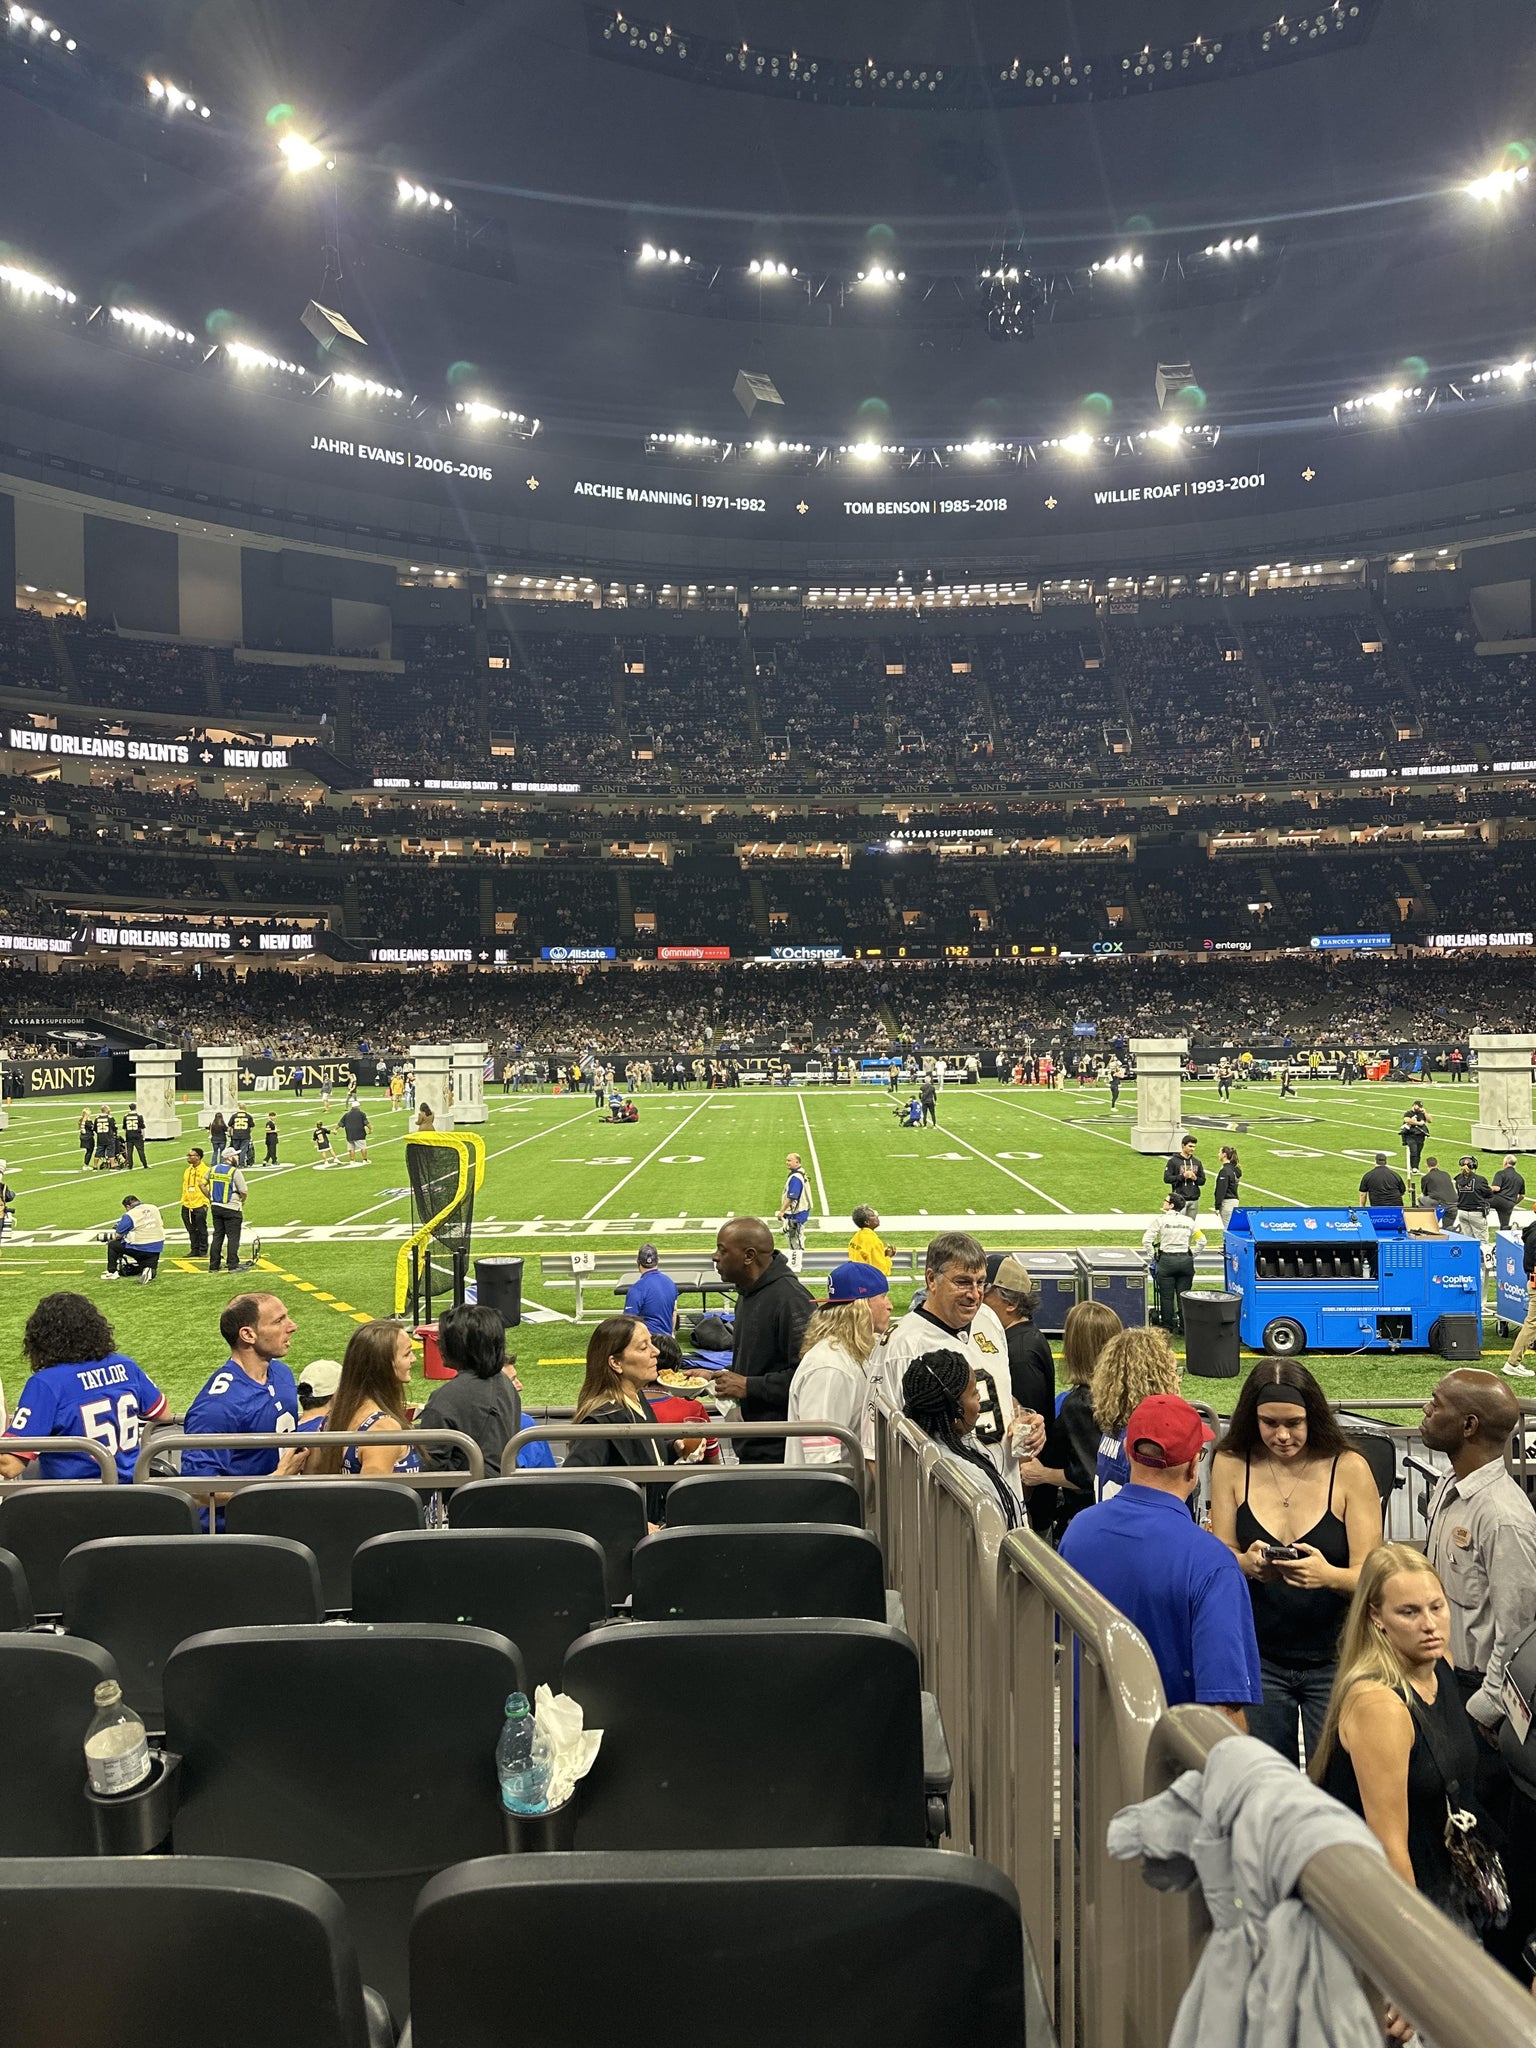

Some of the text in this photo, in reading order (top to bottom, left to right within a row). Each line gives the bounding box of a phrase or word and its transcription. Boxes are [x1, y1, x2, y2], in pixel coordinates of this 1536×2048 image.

[311, 436, 493, 481] JAHRI EVANS 2006-2016
[1094, 474, 1265, 505] WILLIE ROAF 1993-2001
[574, 481, 766, 512] ARCHIE MANNING 1971-1982
[844, 499, 1007, 515] TOM BENSON 1985-2018
[10, 729, 189, 764] NEW ORLEANS SAINTS
[224, 748, 259, 767] NEW
[1402, 764, 1478, 776] NEW ORLEANS SAINTS
[1206, 775, 1243, 784] SAINTS
[1288, 771, 1325, 781] SAINTS
[424, 780, 499, 790] NEW ORLEANS SAINTS
[511, 782, 527, 791] NEW
[528, 783, 558, 792] ORLEANS
[971, 784, 1007, 792] SAINTS
[1048, 781, 1084, 790] SAINTS
[1127, 778, 1164, 787] SAINTS
[592, 785, 628, 793] SAINTS
[669, 786, 705, 794] SAINTS
[744, 786, 779, 794] SAINTS
[820, 786, 855, 794] SAINTS
[894, 785, 930, 793] SAINTS
[9, 794, 46, 808] SAINTS
[90, 804, 127, 817] SAINTS
[1456, 810, 1492, 819] SAINTS
[171, 813, 208, 824] SAINTS
[1215, 820, 1249, 828] SAINTS
[1295, 816, 1329, 826] SAINTS
[1373, 814, 1408, 823] SAINTS
[252, 819, 289, 830] SAINTS
[336, 824, 373, 835] SAINTS
[1065, 826, 1098, 834] SAINTS
[1140, 823, 1173, 832] SAINTS
[416, 828, 450, 836] SAINTS
[496, 829, 528, 838] SAINTS
[569, 831, 601, 839] SAINTS
[939, 829, 994, 837] SUPERDOME
[994, 828, 1026, 836] SAINTS
[13, 936, 48, 951] ORLEANS
[120, 929, 178, 947] ORLEANS
[179, 931, 230, 949] SAINTS
[259, 934, 290, 949] NEW
[1435, 934, 1487, 947] ORLEANS
[1488, 932, 1533, 946] SAINTS
[899, 947, 906, 957] 0
[1011, 945, 1018, 955] 0
[1051, 946, 1057, 956] 3
[1147, 941, 1184, 950] SAINTS
[1215, 940, 1251, 953] entergy
[379, 949, 429, 961] ORLEANS
[430, 949, 472, 961] SAINTS
[620, 949, 654, 957] SAINTS
[661, 947, 704, 958] Community
[782, 947, 840, 959] Ochsner
[31, 1065, 95, 1091] SAINTS
[97, 1122, 109, 1133] 25
[126, 1120, 138, 1131] 25
[1442, 1275, 1474, 1283] Copilot
[1504, 1282, 1526, 1297] Copilot
[77, 1364, 129, 1390] TAYLOR
[208, 1372, 234, 1395] 6
[12, 1407, 32, 1430] 6
[81, 1392, 140, 1456] 56
